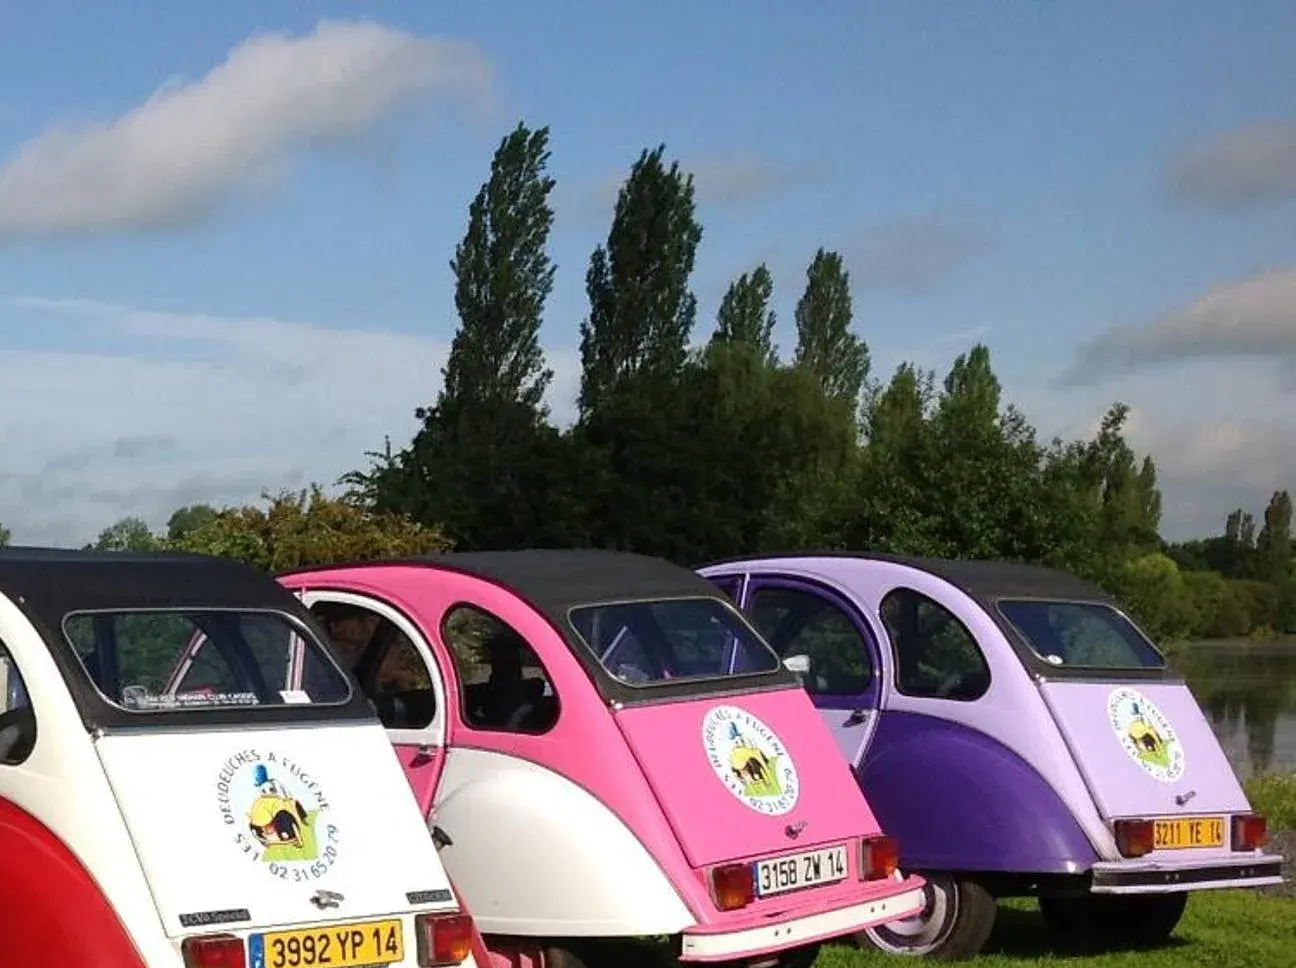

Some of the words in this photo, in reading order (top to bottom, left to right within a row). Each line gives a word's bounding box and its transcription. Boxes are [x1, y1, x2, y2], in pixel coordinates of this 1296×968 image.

[269, 863, 289, 880] 02
[292, 868, 310, 882] 31
[310, 860, 328, 879] 65
[322, 845, 338, 866] 20
[761, 861, 798, 890] 3158
[803, 853, 822, 882] ZW
[828, 850, 844, 876] 14
[271, 935, 332, 968] 3992
[336, 931, 364, 960] YP
[372, 926, 399, 957] 14
